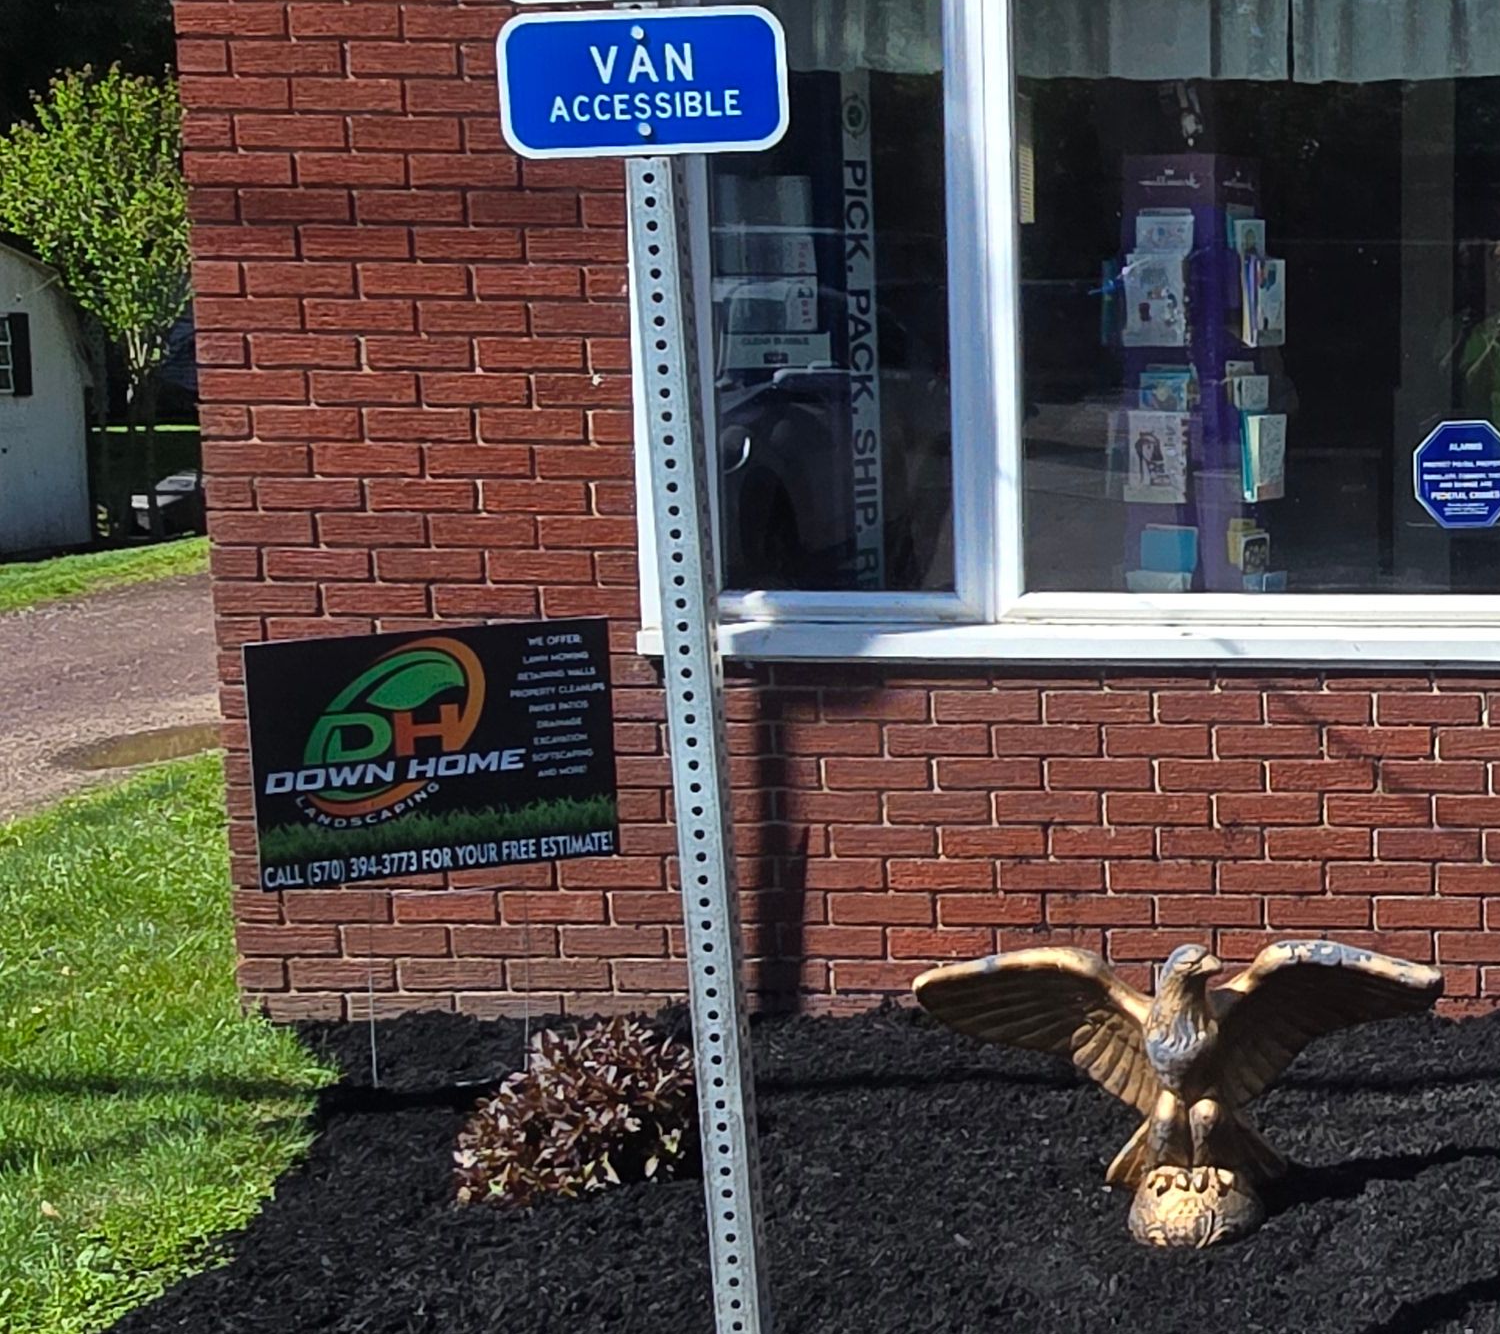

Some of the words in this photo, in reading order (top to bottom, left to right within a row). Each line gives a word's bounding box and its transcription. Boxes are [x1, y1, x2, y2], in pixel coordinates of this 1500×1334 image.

[590, 42, 694, 84] VAN
[550, 89, 742, 123] ACCESSIBLE
[510, 687, 556, 698] PROPERTY
[533, 733, 588, 745] EXCAVATION
[265, 761, 395, 795] DOWN
[407, 748, 526, 779] HOME
[296, 781, 440, 829] LANDSCAPING
[264, 864, 304, 888] CALL
[307, 859, 346, 884] (570)
[350, 850, 417, 877] 394-3773
[422, 847, 452, 869] FOR
[455, 841, 498, 865] YOUR
[502, 838, 536, 861] FREE
[541, 830, 614, 857] ESTIMATE!
